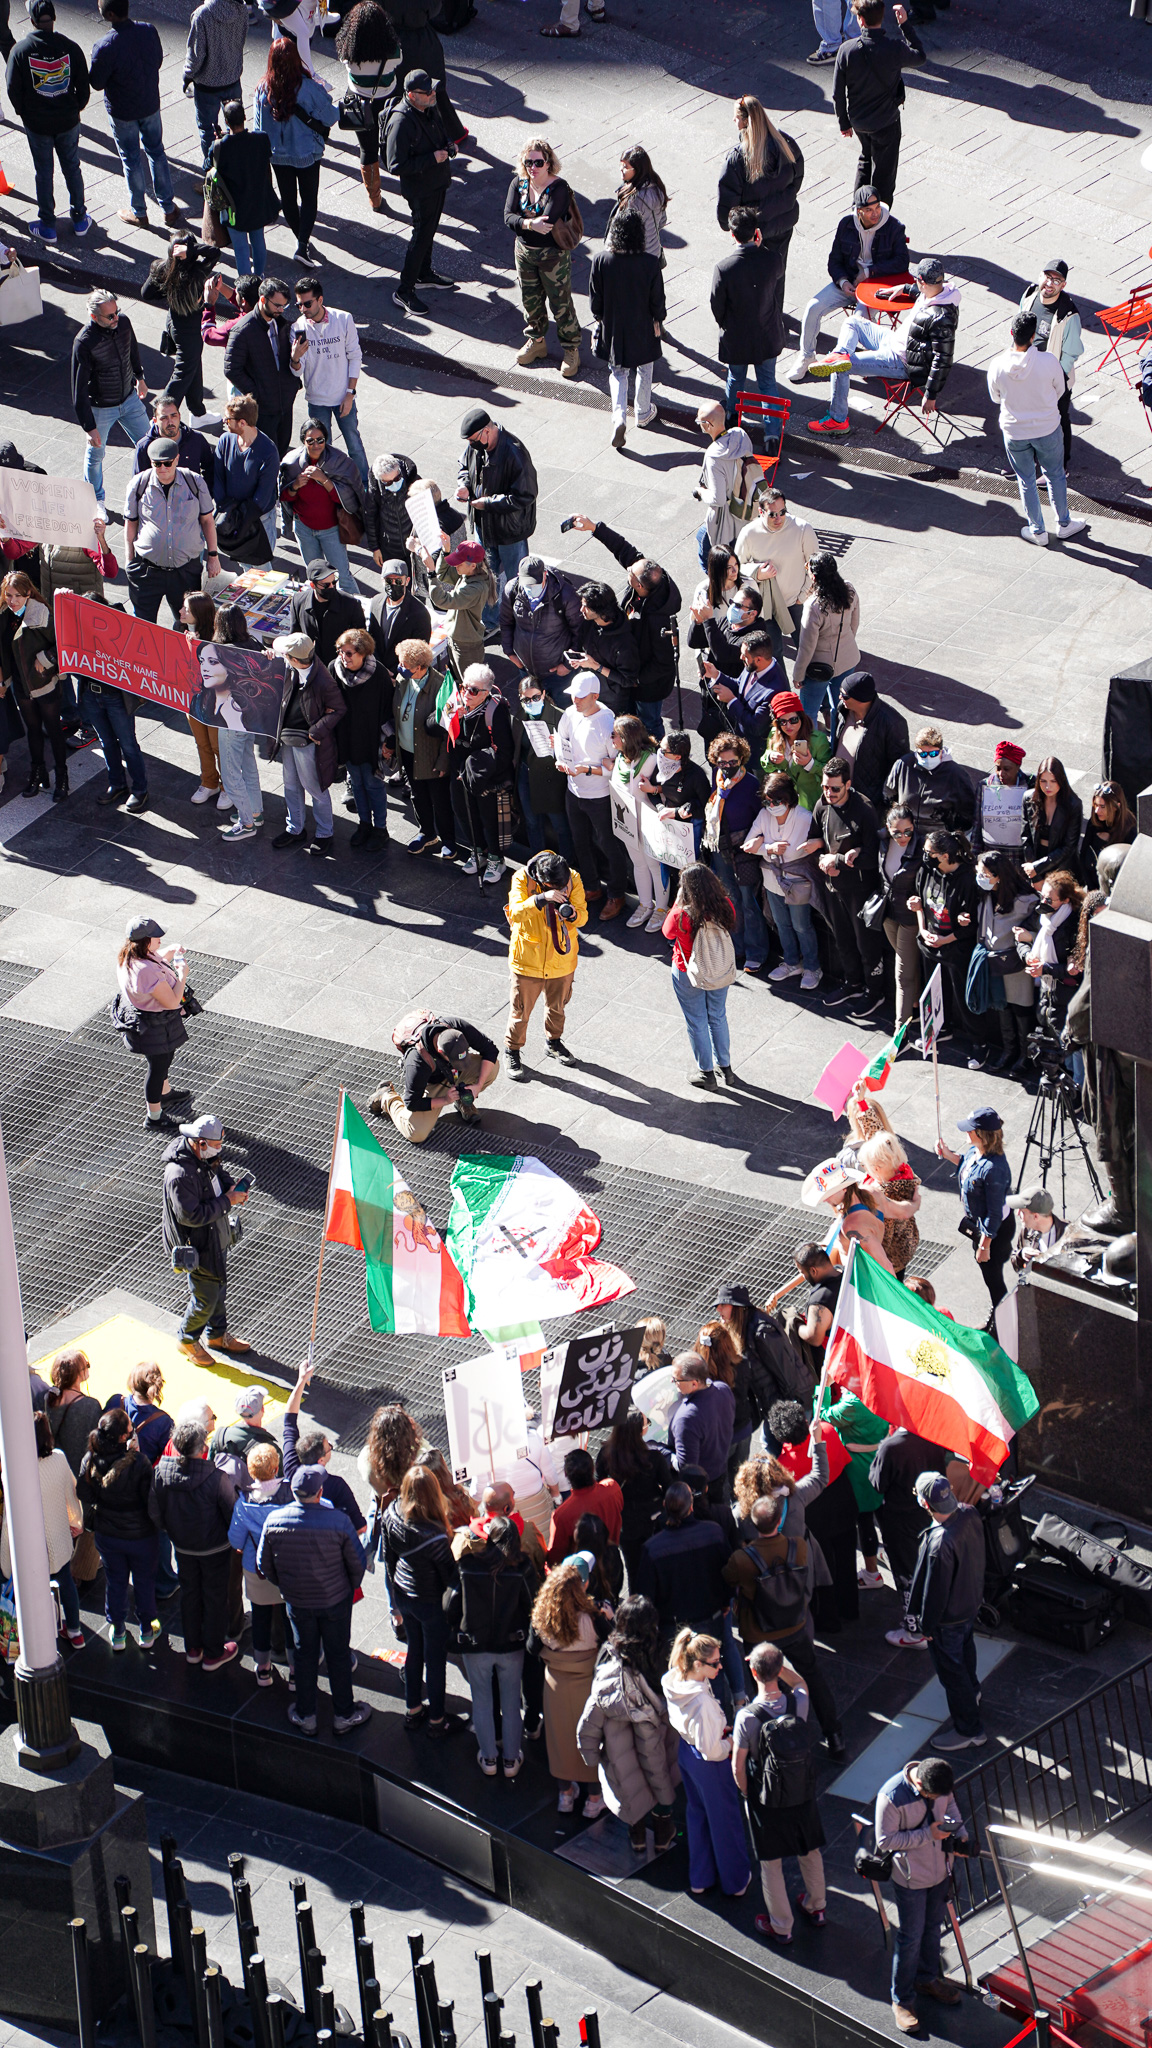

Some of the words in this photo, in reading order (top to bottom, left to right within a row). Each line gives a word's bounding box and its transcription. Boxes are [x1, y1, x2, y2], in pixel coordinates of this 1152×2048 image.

[317, 336, 340, 345] STRAUSS
[11, 478, 75, 500] WOMEN
[32, 499, 66, 517] LIFE
[15, 513, 82, 534] FREEDOM
[61, 596, 192, 690] IRAN
[95, 650, 111, 661] SAY
[114, 659, 131, 670] HER
[133, 667, 158, 680] NAME
[62, 650, 131, 685] MAHSA
[140, 678, 190, 708] AMINI
[822, 1163, 837, 1175] NYC
[578, 1335, 624, 1373] زن
[561, 1354, 633, 1408] زندگی
